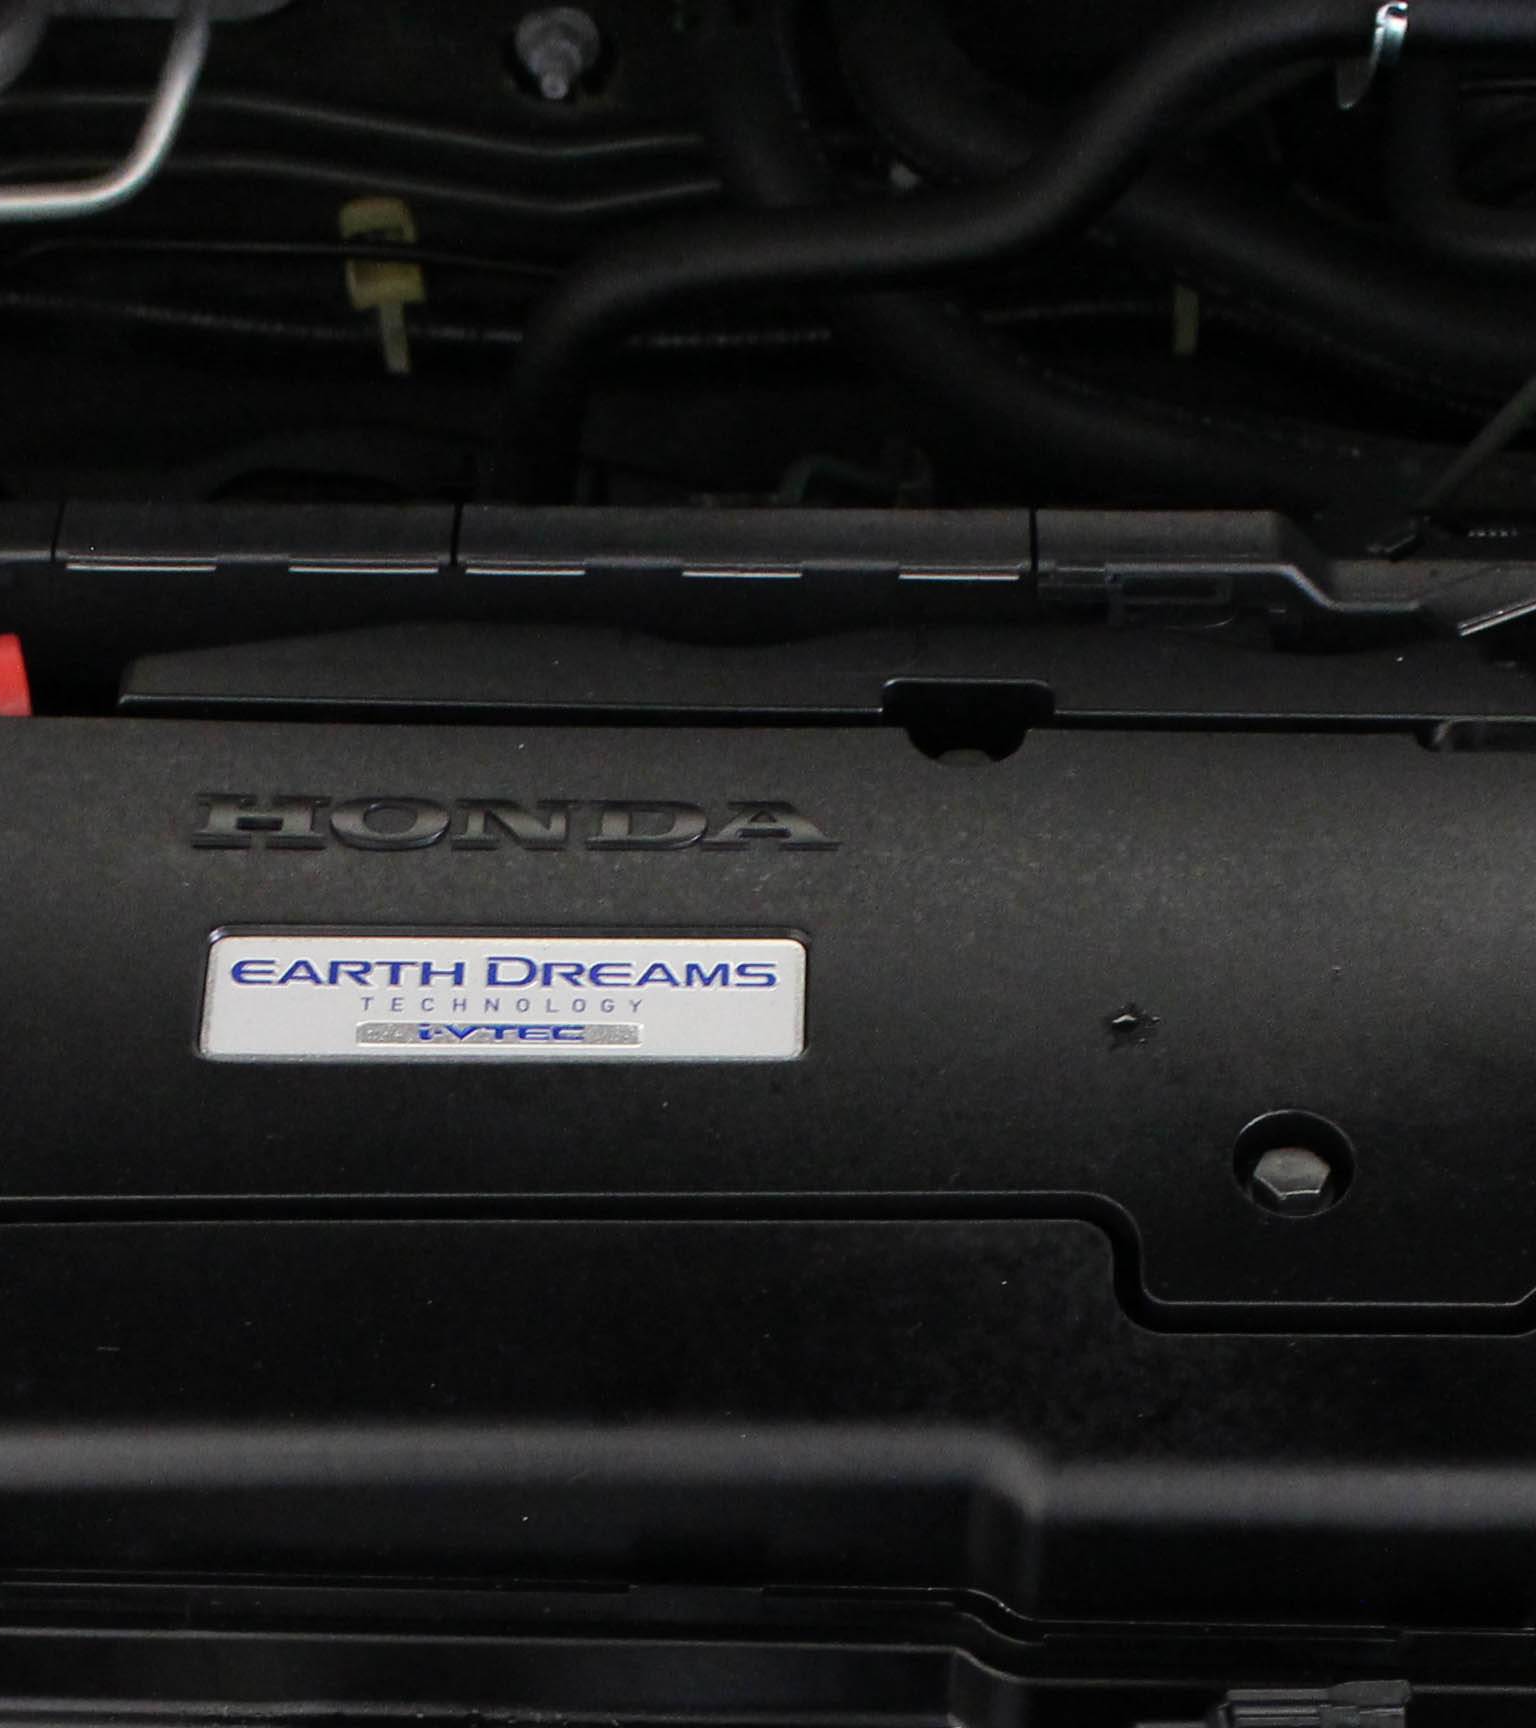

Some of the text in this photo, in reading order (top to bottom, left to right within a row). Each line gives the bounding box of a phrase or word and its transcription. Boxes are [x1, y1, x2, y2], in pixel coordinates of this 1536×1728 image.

[189, 793, 839, 852] HONDA
[230, 955, 778, 989] EARTH DREAMS
[360, 997, 645, 1014] TECHNOLOGY
[417, 1022, 586, 1042] i-VTEC
